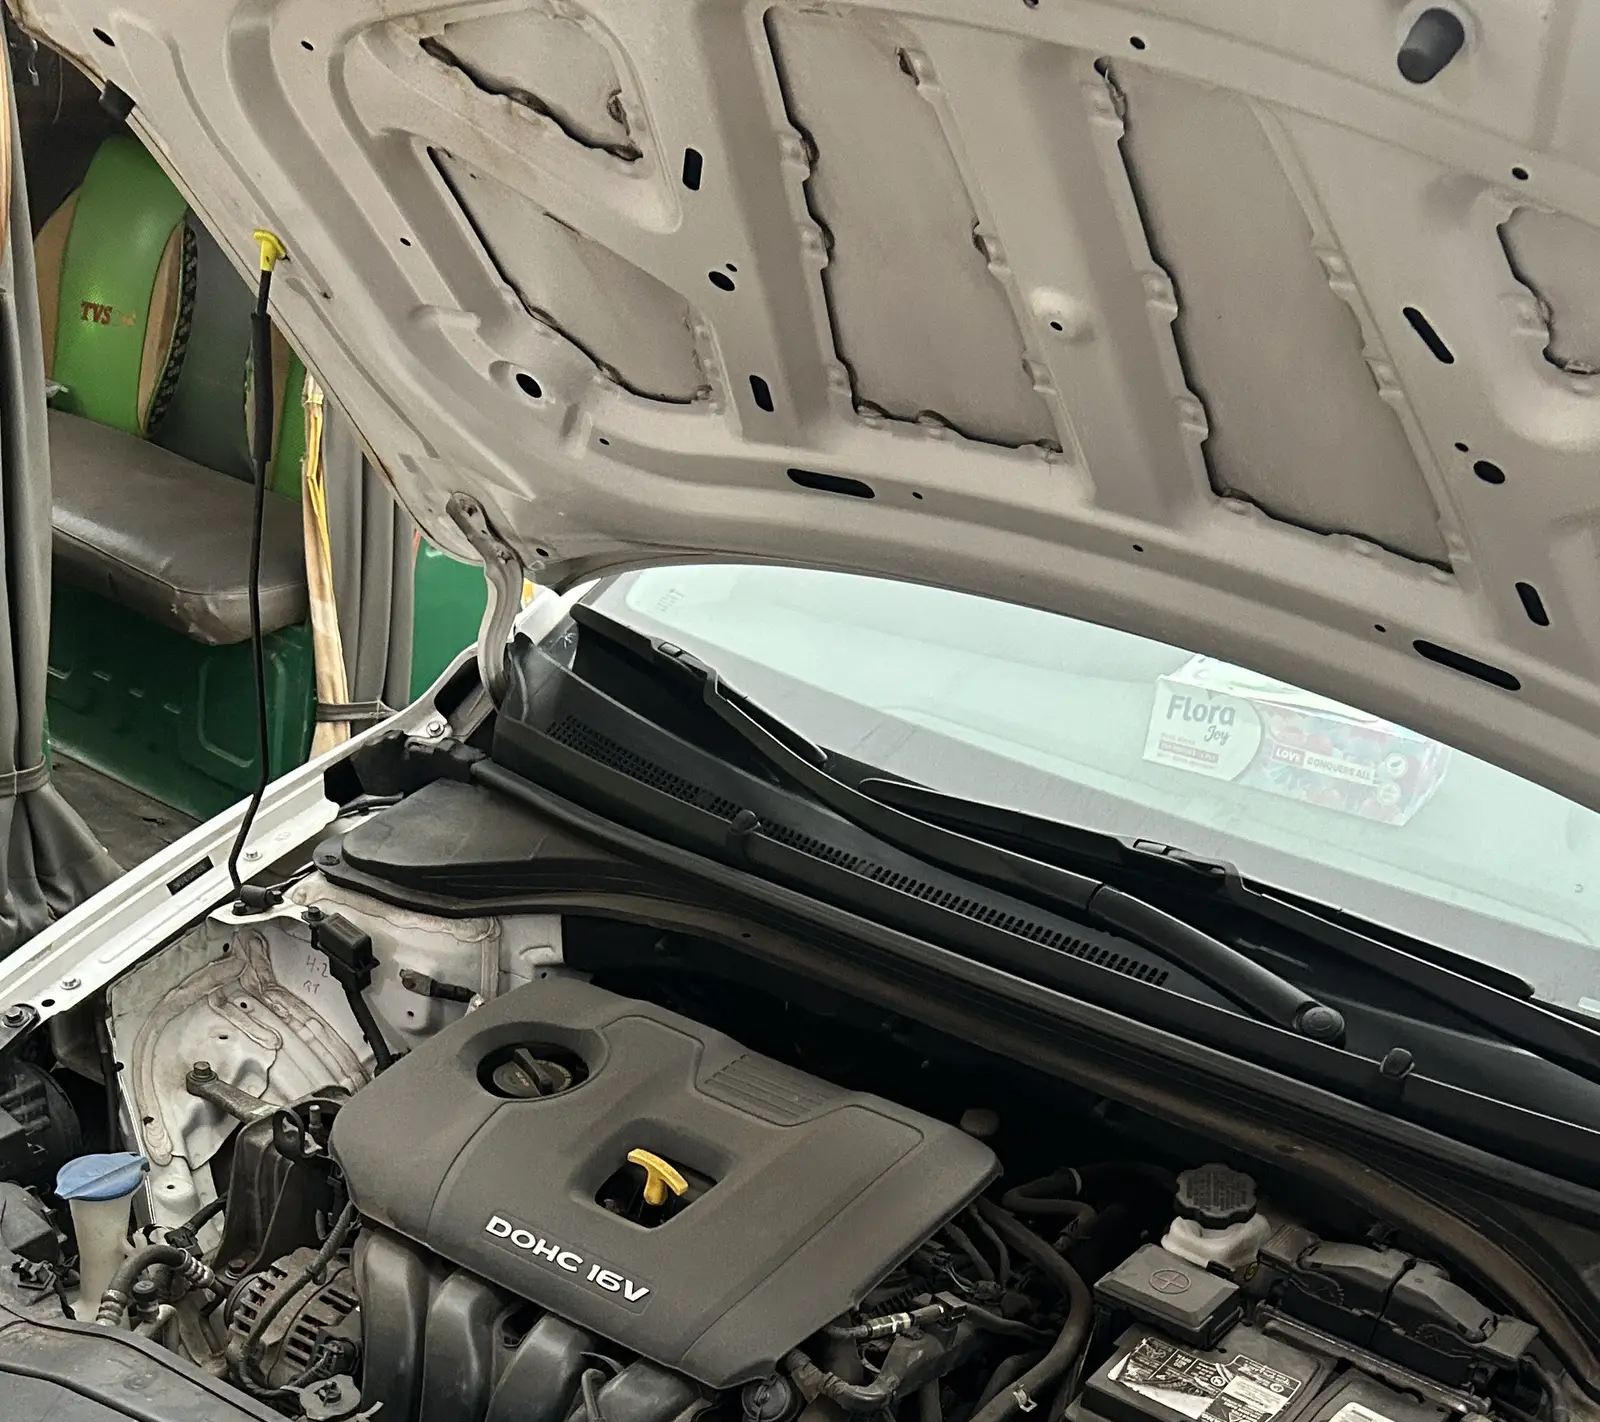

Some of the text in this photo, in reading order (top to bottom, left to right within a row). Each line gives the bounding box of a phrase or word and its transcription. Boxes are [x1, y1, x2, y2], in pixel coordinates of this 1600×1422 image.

[81, 300, 113, 325] TVS
[1166, 694, 1236, 726] Flora
[1204, 725, 1230, 746] Joy
[1275, 747, 1303, 764] LOVE
[485, 1215, 650, 1303] DOHC 16V
